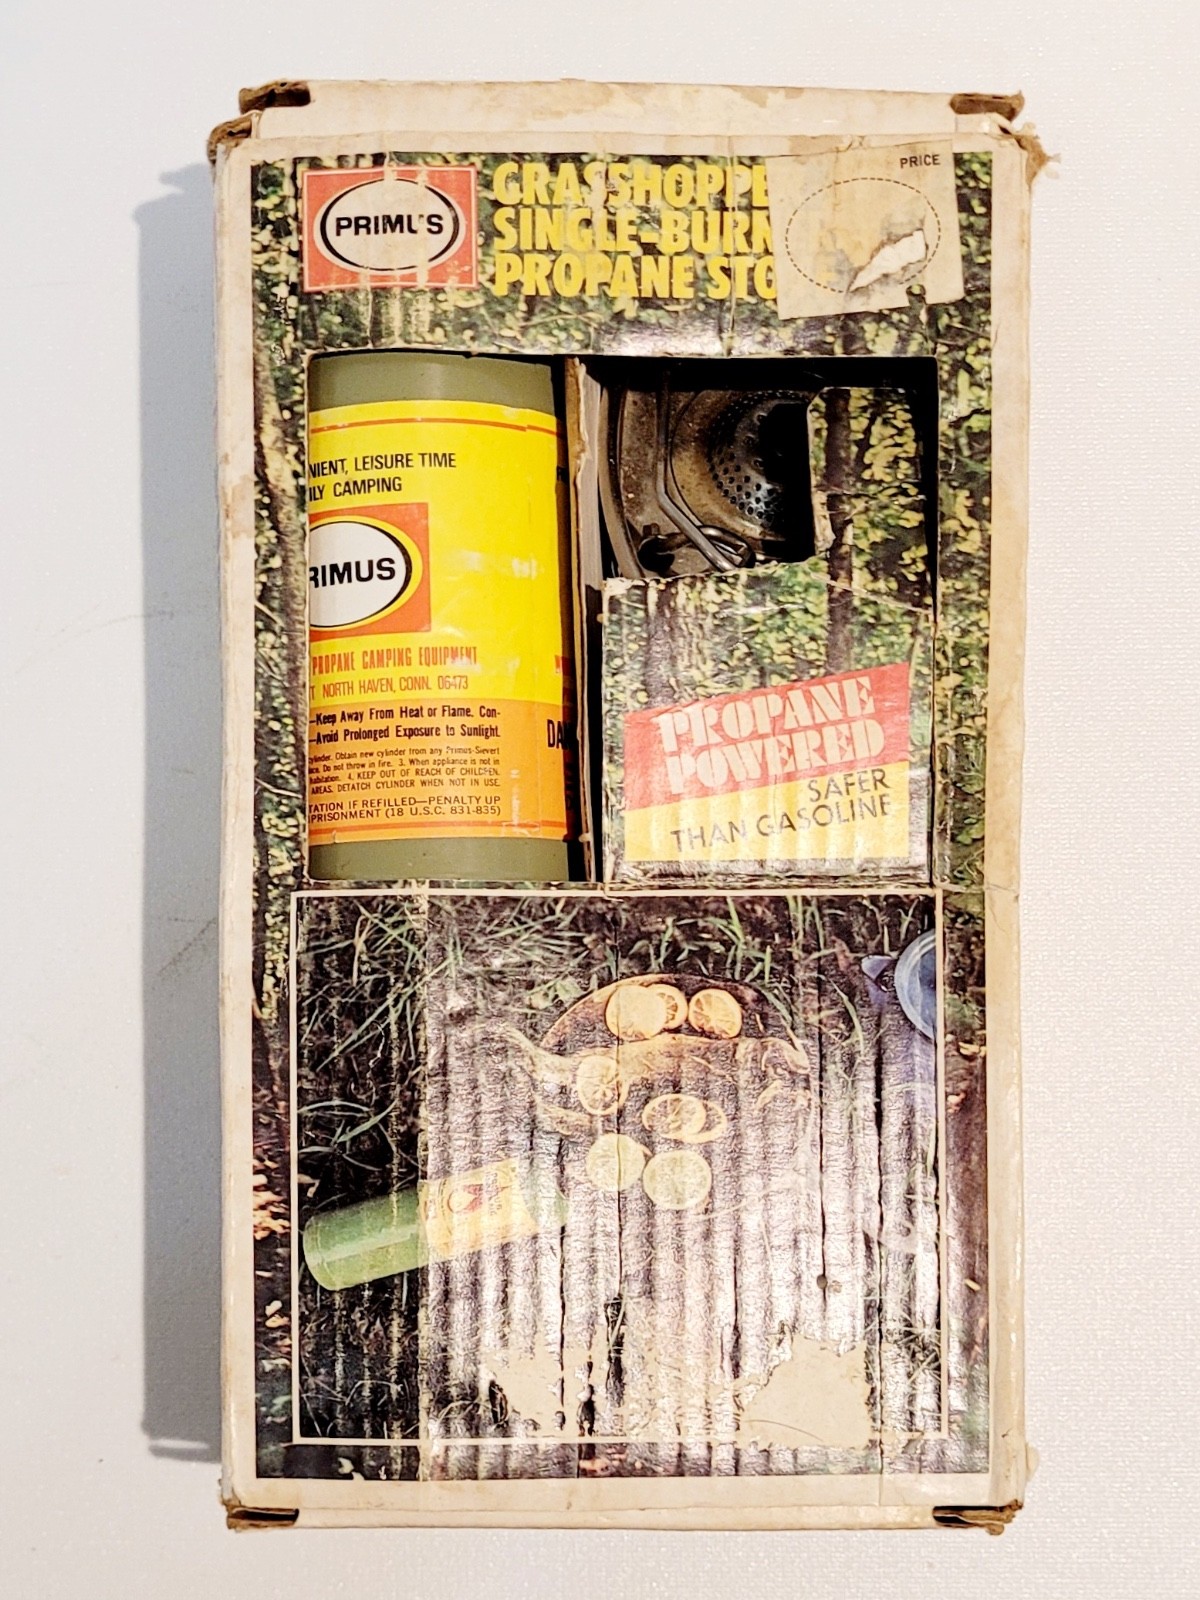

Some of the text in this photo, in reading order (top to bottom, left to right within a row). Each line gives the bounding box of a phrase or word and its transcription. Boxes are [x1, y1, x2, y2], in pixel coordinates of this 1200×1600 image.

[900, 154, 941, 169] PRICE
[494, 252, 695, 299] PROPANE
[354, 453, 414, 472] LEISURE
[417, 452, 456, 468] TIME
[333, 476, 402, 498] CAMPING
[312, 646, 477, 676] PROPANE CAMPING EQUIPMENT
[322, 680, 354, 699] NORTH
[359, 677, 396, 693] HAVEN,
[399, 675, 432, 691] CONN.
[437, 674, 469, 690] 06473
[340, 710, 364, 723] Away
[369, 707, 394, 720] From
[399, 705, 424, 718] Heat
[427, 707, 437, 717] or
[441, 704, 474, 718] Flame.
[479, 705, 501, 718] Con-
[652, 676, 876, 752] PROPANE
[343, 727, 390, 742] Prolonged
[395, 724, 441, 740] Exposure
[445, 724, 455, 737] to
[460, 723, 501, 740] Sunlight.
[335, 752, 357, 761] Obtain
[376, 748, 406, 758] cylinder
[409, 747, 427, 755] from
[429, 748, 443, 756] any
[665, 718, 886, 795] POWERED
[322, 764, 331, 773] Do
[333, 763, 344, 771] not
[346, 761, 366, 770] throw
[368, 760, 376, 768] in
[378, 759, 393, 768] fire.
[398, 758, 406, 767] 3.
[408, 757, 430, 766] When
[432, 755, 468, 767] appliance
[470, 756, 477, 765] is
[479, 757, 491, 766] not
[357, 770, 376, 780] KEEP
[379, 769, 396, 778] OUT
[400, 768, 411, 777] OF
[415, 767, 441, 777] REACH
[445, 767, 456, 776] OF
[337, 781, 371, 793] DETATCH
[375, 779, 415, 790] CYLINDER
[420, 778, 444, 787] WHEN
[449, 778, 466, 787] NOT
[470, 778, 479, 787] IN
[807, 768, 892, 803] SAFER
[348, 799, 358, 810] IF
[484, 795, 501, 806] UP
[385, 807, 405, 819] (18
[410, 805, 446, 817] U.S.C.
[450, 805, 501, 816] 831-835)
[670, 793, 892, 853] THAN GASOLINE
